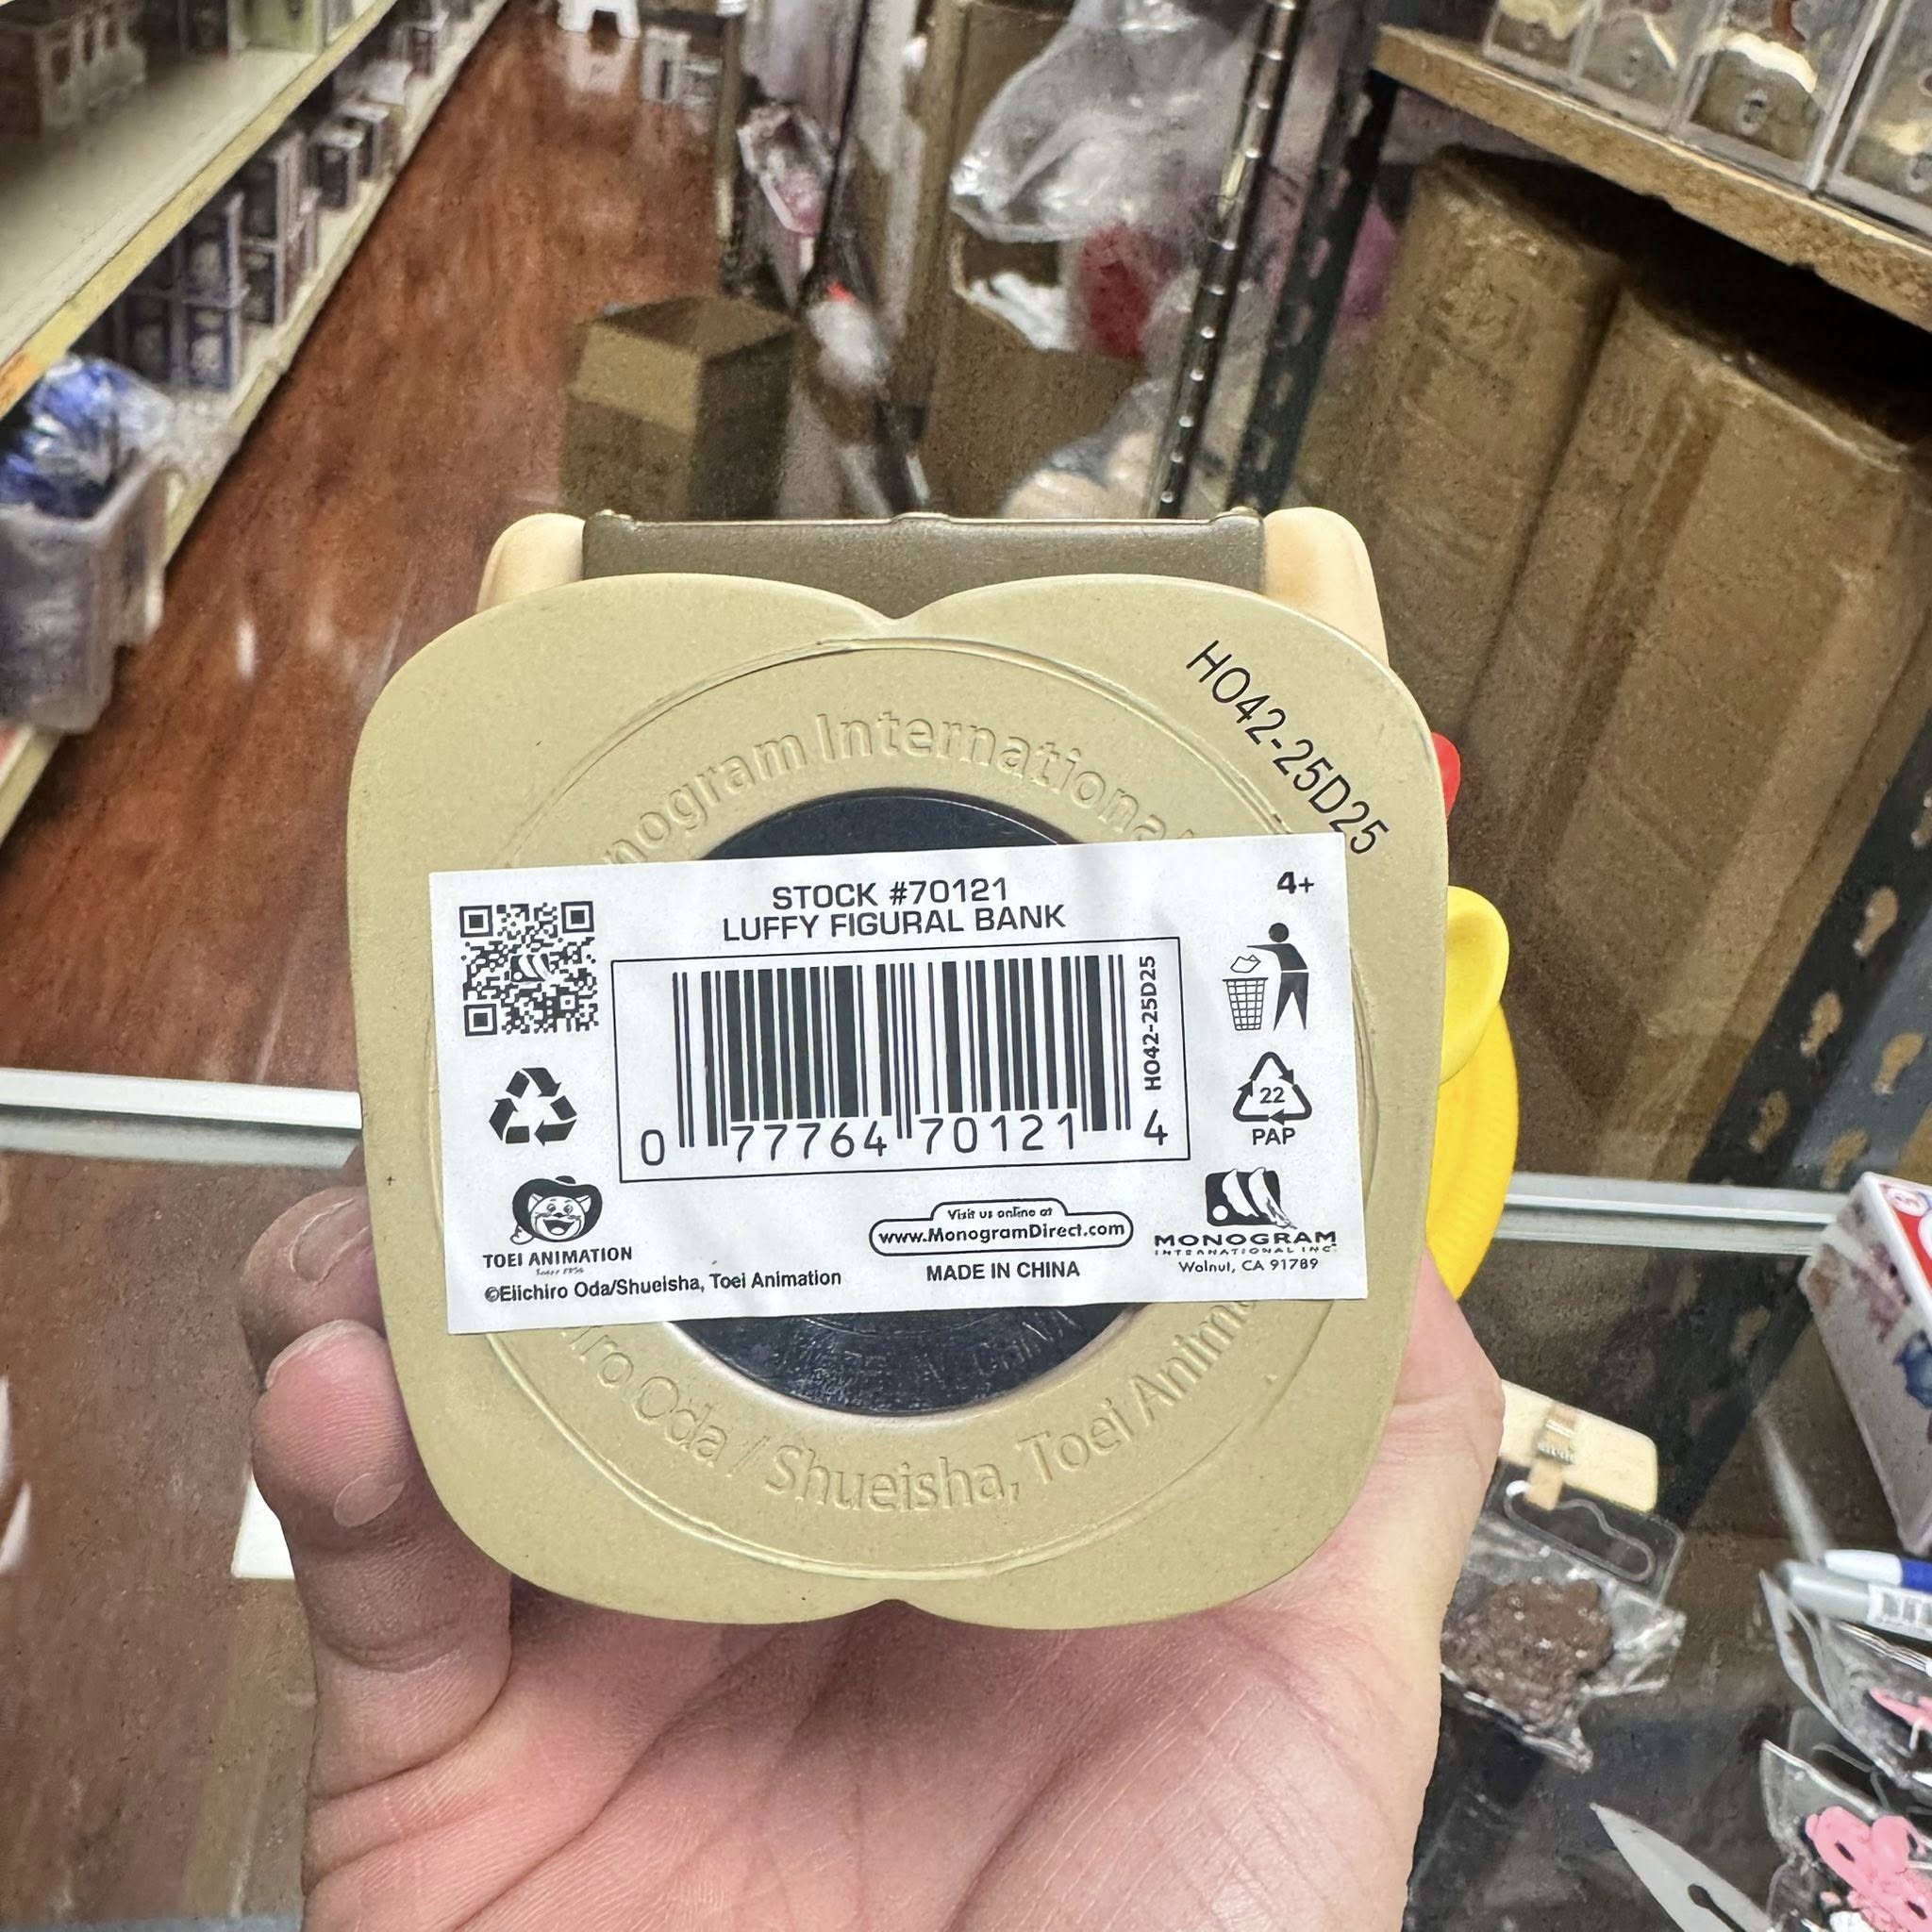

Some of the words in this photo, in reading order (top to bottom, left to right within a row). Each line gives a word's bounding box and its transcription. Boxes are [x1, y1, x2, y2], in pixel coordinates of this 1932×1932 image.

[816, 712, 1195, 841] Internationa
[772, 882, 878, 910] STOCK
[890, 877, 1007, 906] #70121
[1277, 872, 1314, 894] 4+
[724, 914, 820, 941] LUFFY
[831, 908, 964, 937] FIGURAL
[975, 904, 1066, 931] BANK
[1259, 1087, 1286, 1105] 22
[641, 1129, 665, 1166] 0
[730, 1122, 887, 1162] 77764
[920, 1112, 1074, 1154] 70121
[1143, 1109, 1168, 1145] 4
[1252, 1127, 1296, 1145] PAP
[878, 1223, 1124, 1243] www.MonogramDirect.com
[1154, 1230, 1337, 1247] MONOGRAM
[483, 1253, 523, 1269] TOEI
[528, 1246, 632, 1266] ANIMATION
[1241, 1259, 1265, 1272] CA
[1270, 1257, 1319, 1271] 91789
[926, 1264, 985, 1281] MADE
[991, 1262, 1010, 1278] IN
[1017, 1260, 1080, 1278] CHINA
[574, 1274, 705, 1298] Oda/Shueisha,
[709, 1272, 746, 1289] Toei
[751, 1270, 841, 1289] Animation
[1013, 1397, 1134, 1485] Toei
